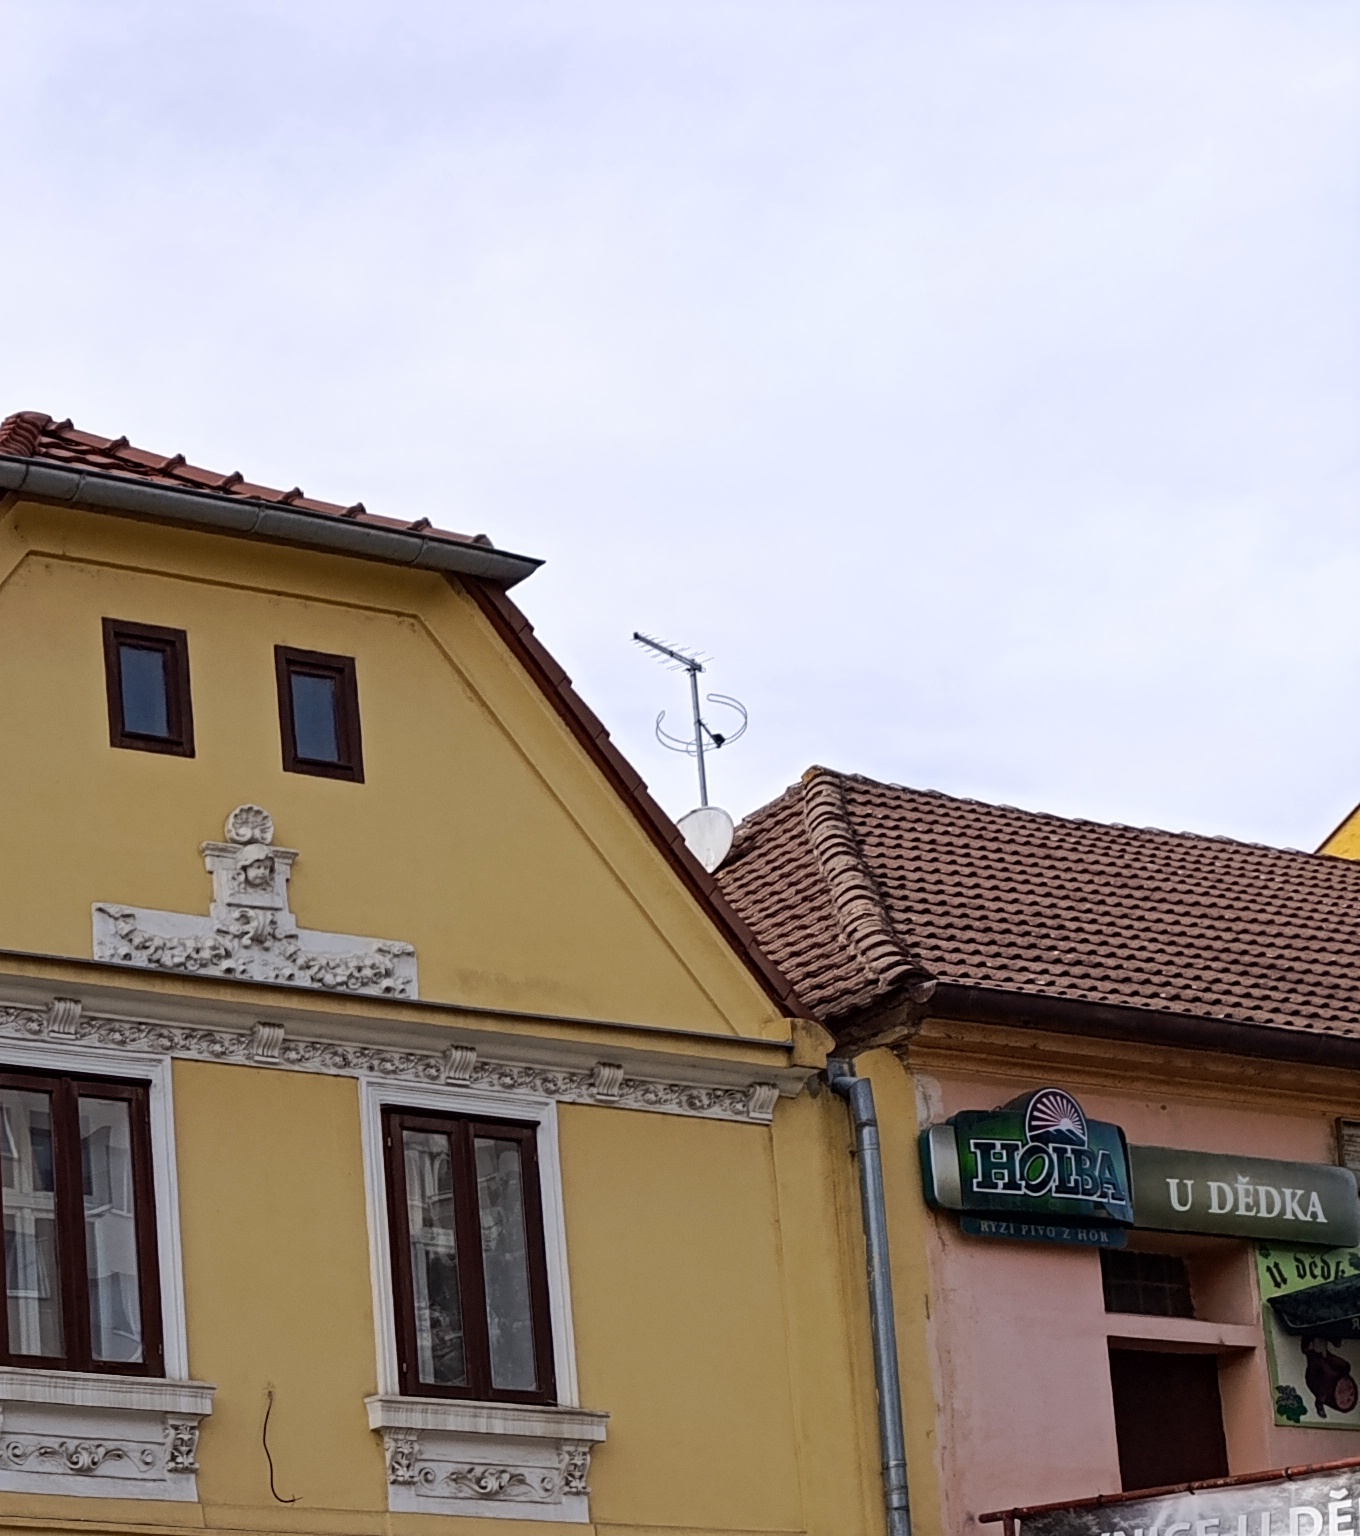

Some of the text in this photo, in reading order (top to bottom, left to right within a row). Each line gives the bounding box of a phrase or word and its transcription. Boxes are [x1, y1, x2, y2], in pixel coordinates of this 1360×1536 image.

[970, 1138, 1127, 1206] HOLBA
[1166, 1175, 1329, 1224] U DĚDKA
[1022, 1224, 1056, 1238] PIVO
[1063, 1228, 1071, 1240] Z
[1078, 1229, 1110, 1243] HOR
